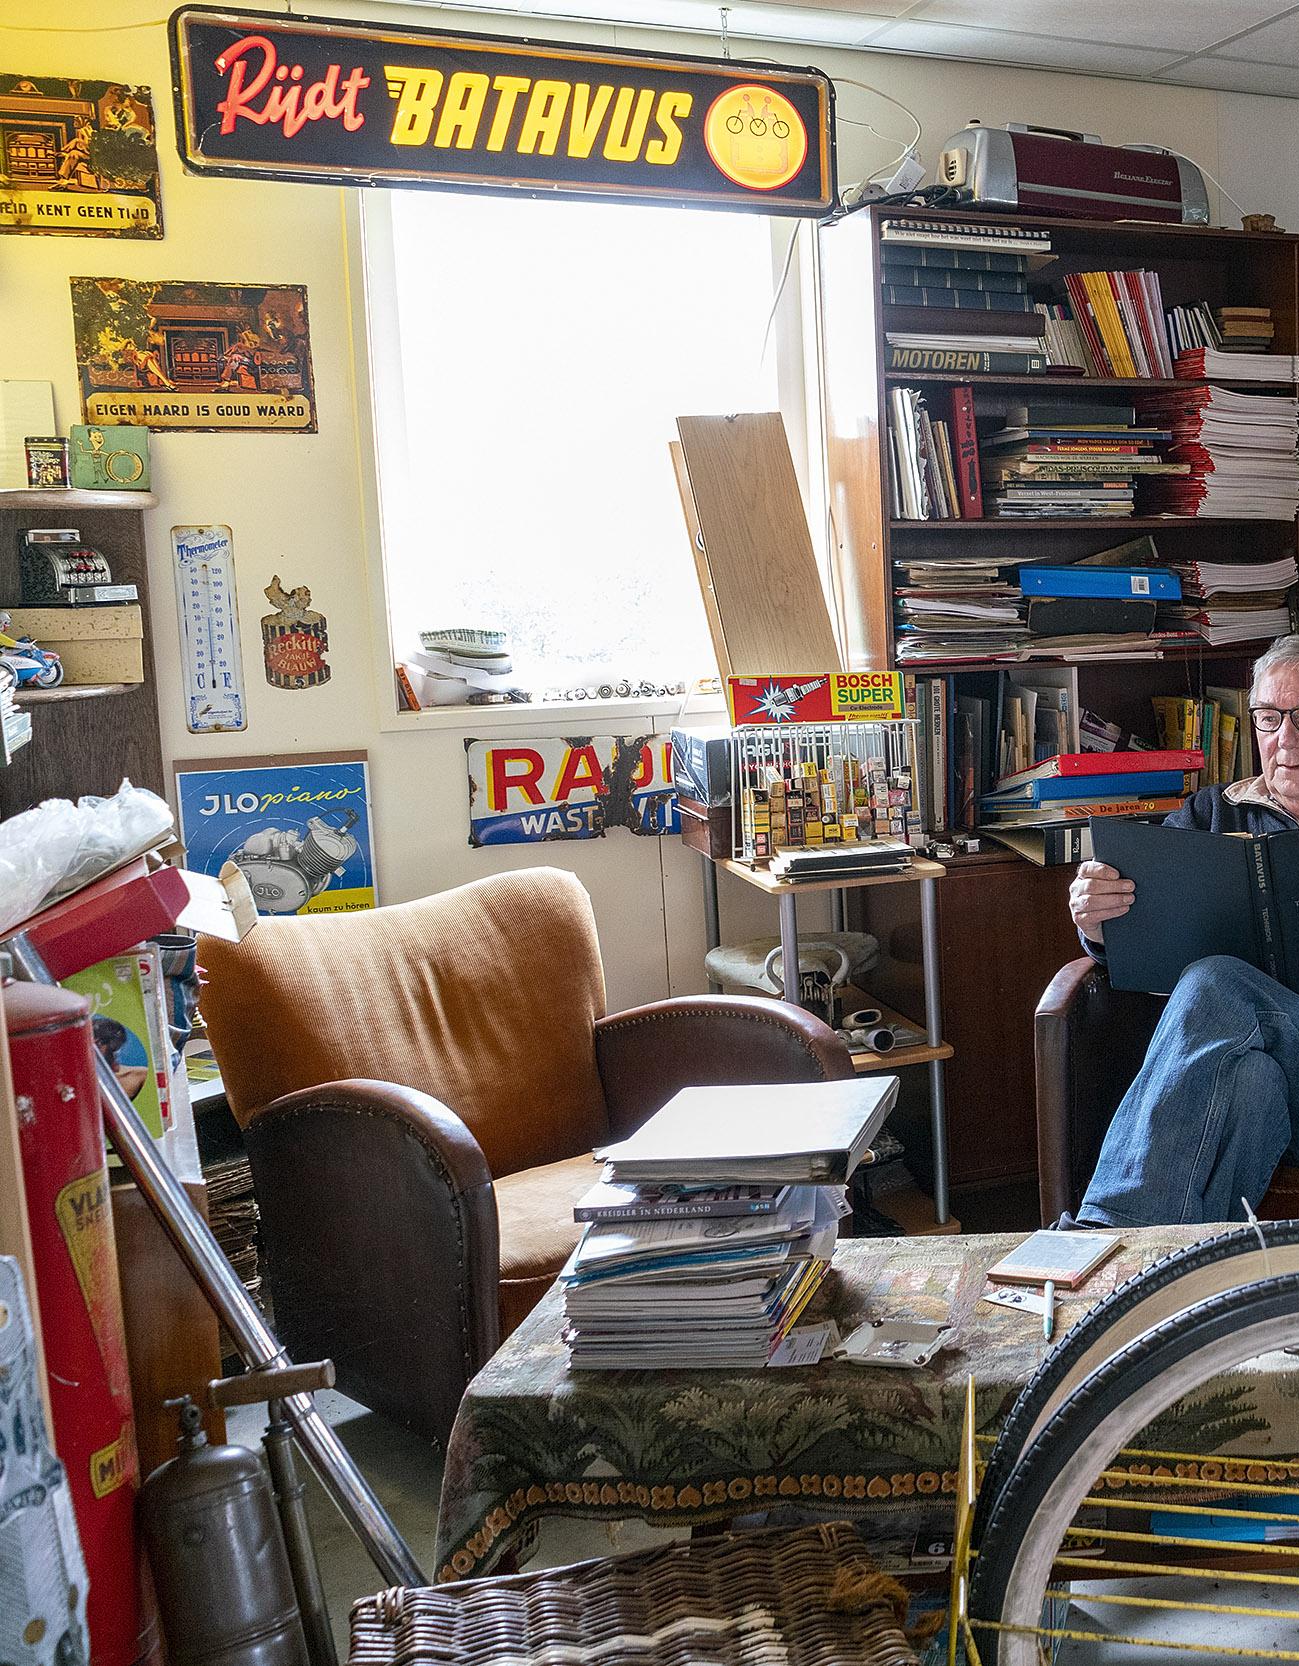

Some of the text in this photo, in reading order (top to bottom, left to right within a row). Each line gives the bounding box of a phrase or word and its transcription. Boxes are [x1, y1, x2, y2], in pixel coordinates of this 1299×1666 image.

[384, 66, 693, 165] BATAVUS
[37, 204, 71, 217] KENT
[77, 206, 113, 218] GEEN
[118, 208, 149, 220] TIJD
[891, 350, 980, 371] MOTOREN
[96, 404, 304, 417] EIGEN HAARD IS GOUD WAARD
[177, 538, 229, 560] Thermometer
[278, 658, 317, 672] BLAUW
[836, 674, 893, 688] BOSCH
[838, 688, 894, 703] SUPER
[200, 786, 362, 816] JLO piano
[1100, 805, 1113, 813] De
[1116, 804, 1140, 813] jaren
[1254, 843, 1266, 889] BATAVUS
[256, 886, 280, 898] JLO
[307, 906, 332, 914] kaum
[345, 902, 370, 911] hören
[597, 1205, 711, 1218] KREIDLER IN NEDERLAND
